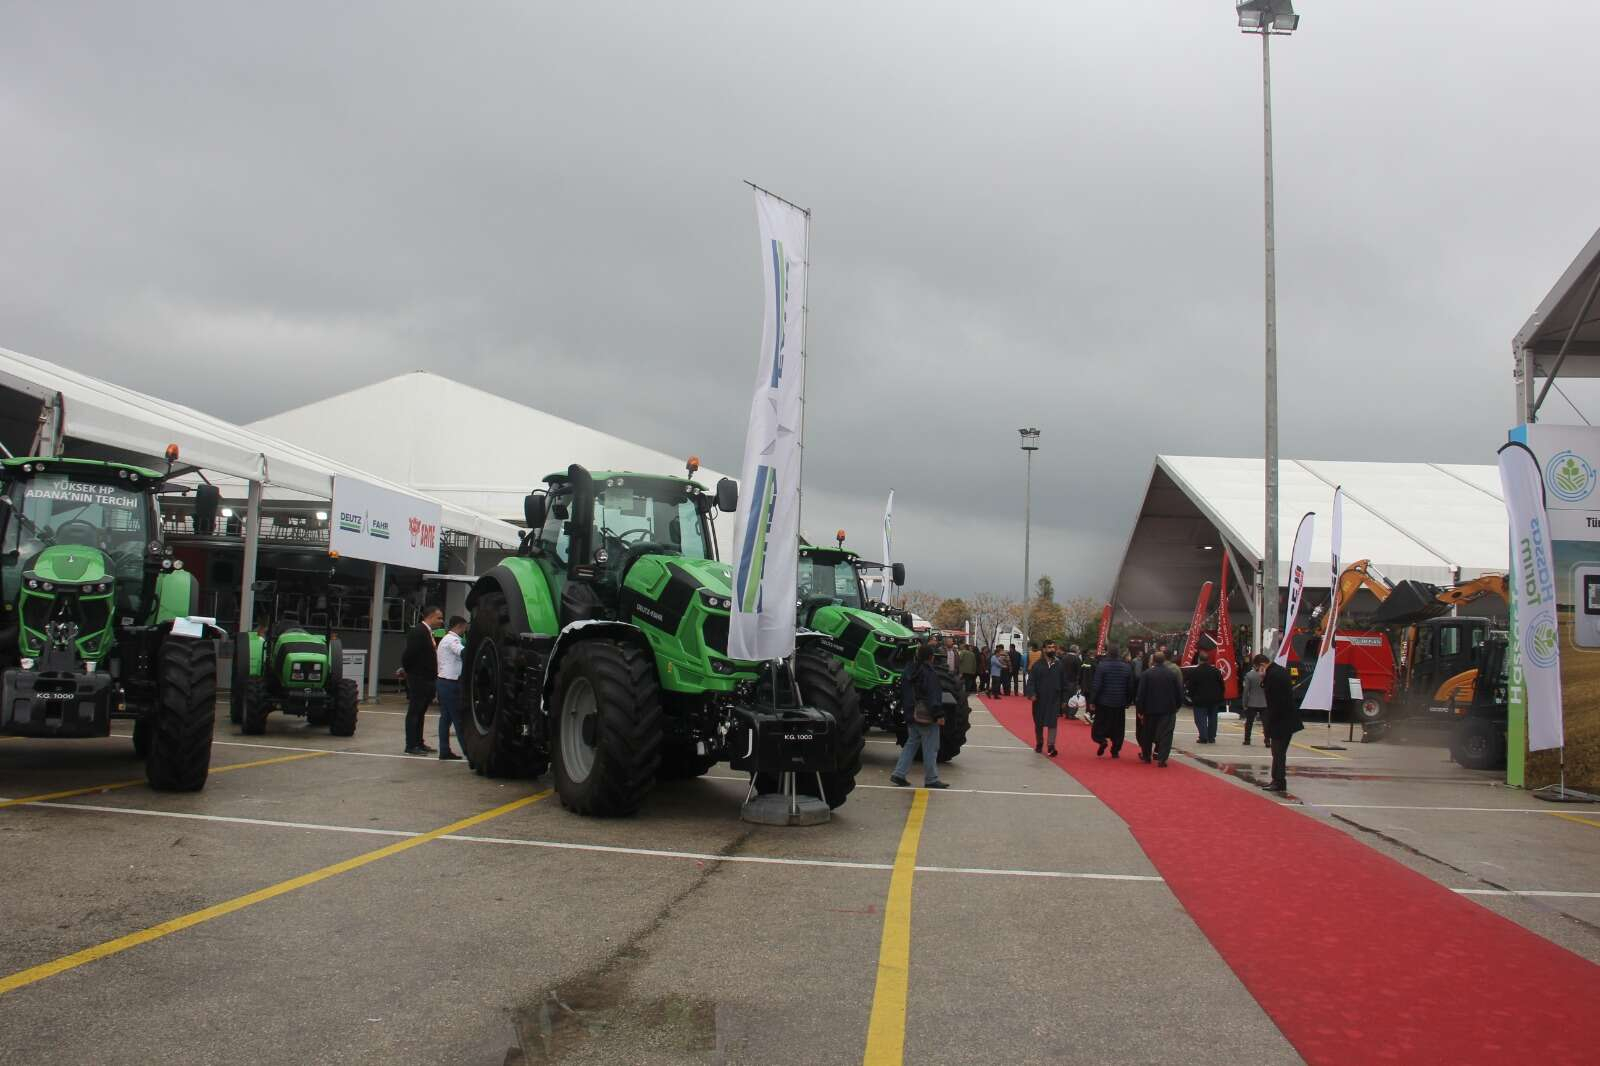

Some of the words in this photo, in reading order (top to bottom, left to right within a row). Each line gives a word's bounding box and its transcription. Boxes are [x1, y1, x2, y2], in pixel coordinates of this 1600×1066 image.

[53, 480, 97, 493] YÜKSEK
[99, 486, 115, 495] HP
[340, 512, 362, 524] DEUTZ
[372, 520, 389, 529] FAHR
[53, 692, 74, 700] 1000
